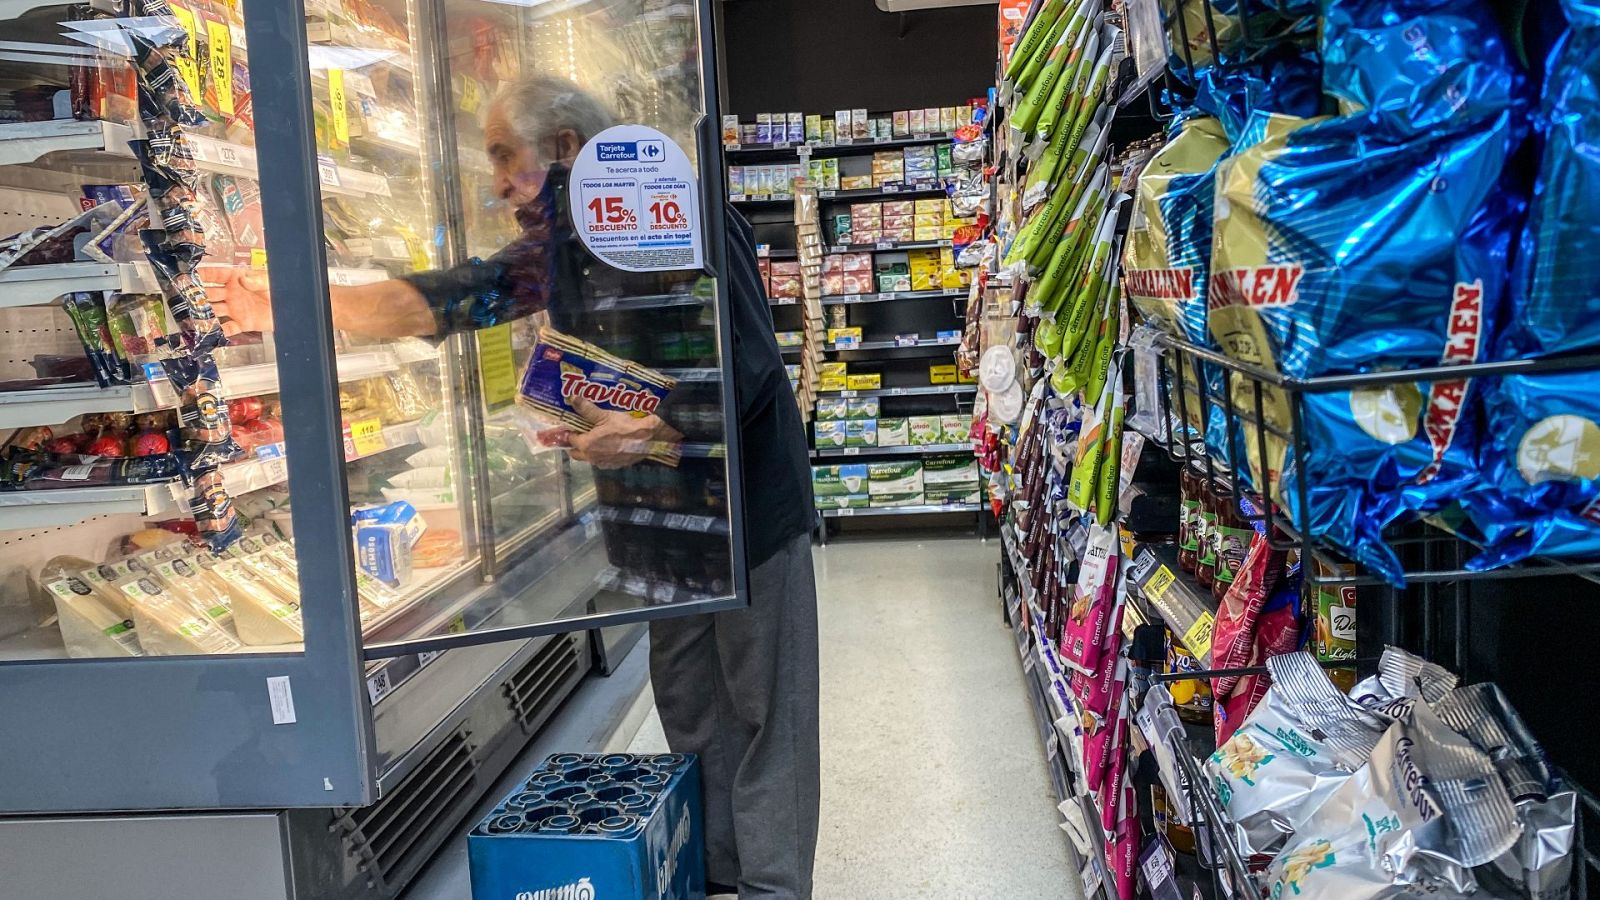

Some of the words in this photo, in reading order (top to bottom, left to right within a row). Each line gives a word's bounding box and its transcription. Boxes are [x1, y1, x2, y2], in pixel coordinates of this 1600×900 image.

[600, 144, 626, 152] Tarjeta
[600, 152, 636, 160] Carrefour
[587, 197, 637, 224] 15%
[649, 202, 687, 224] 10%
[588, 224, 638, 232] DESCUENTO
[590, 235, 629, 243] Descuentos
[674, 232, 692, 240] tope!
[561, 373, 661, 414] Traviata
[367, 536, 379, 577] CREMOSO
[1092, 611, 1104, 646] Carrefour
[1101, 660, 1113, 693] Carrefour
[1099, 734, 1111, 769] Carrefour
[1109, 773, 1120, 807] Carrefour
[1396, 736, 1437, 823] Carrefour
[1124, 843, 1132, 878] Carrefour
